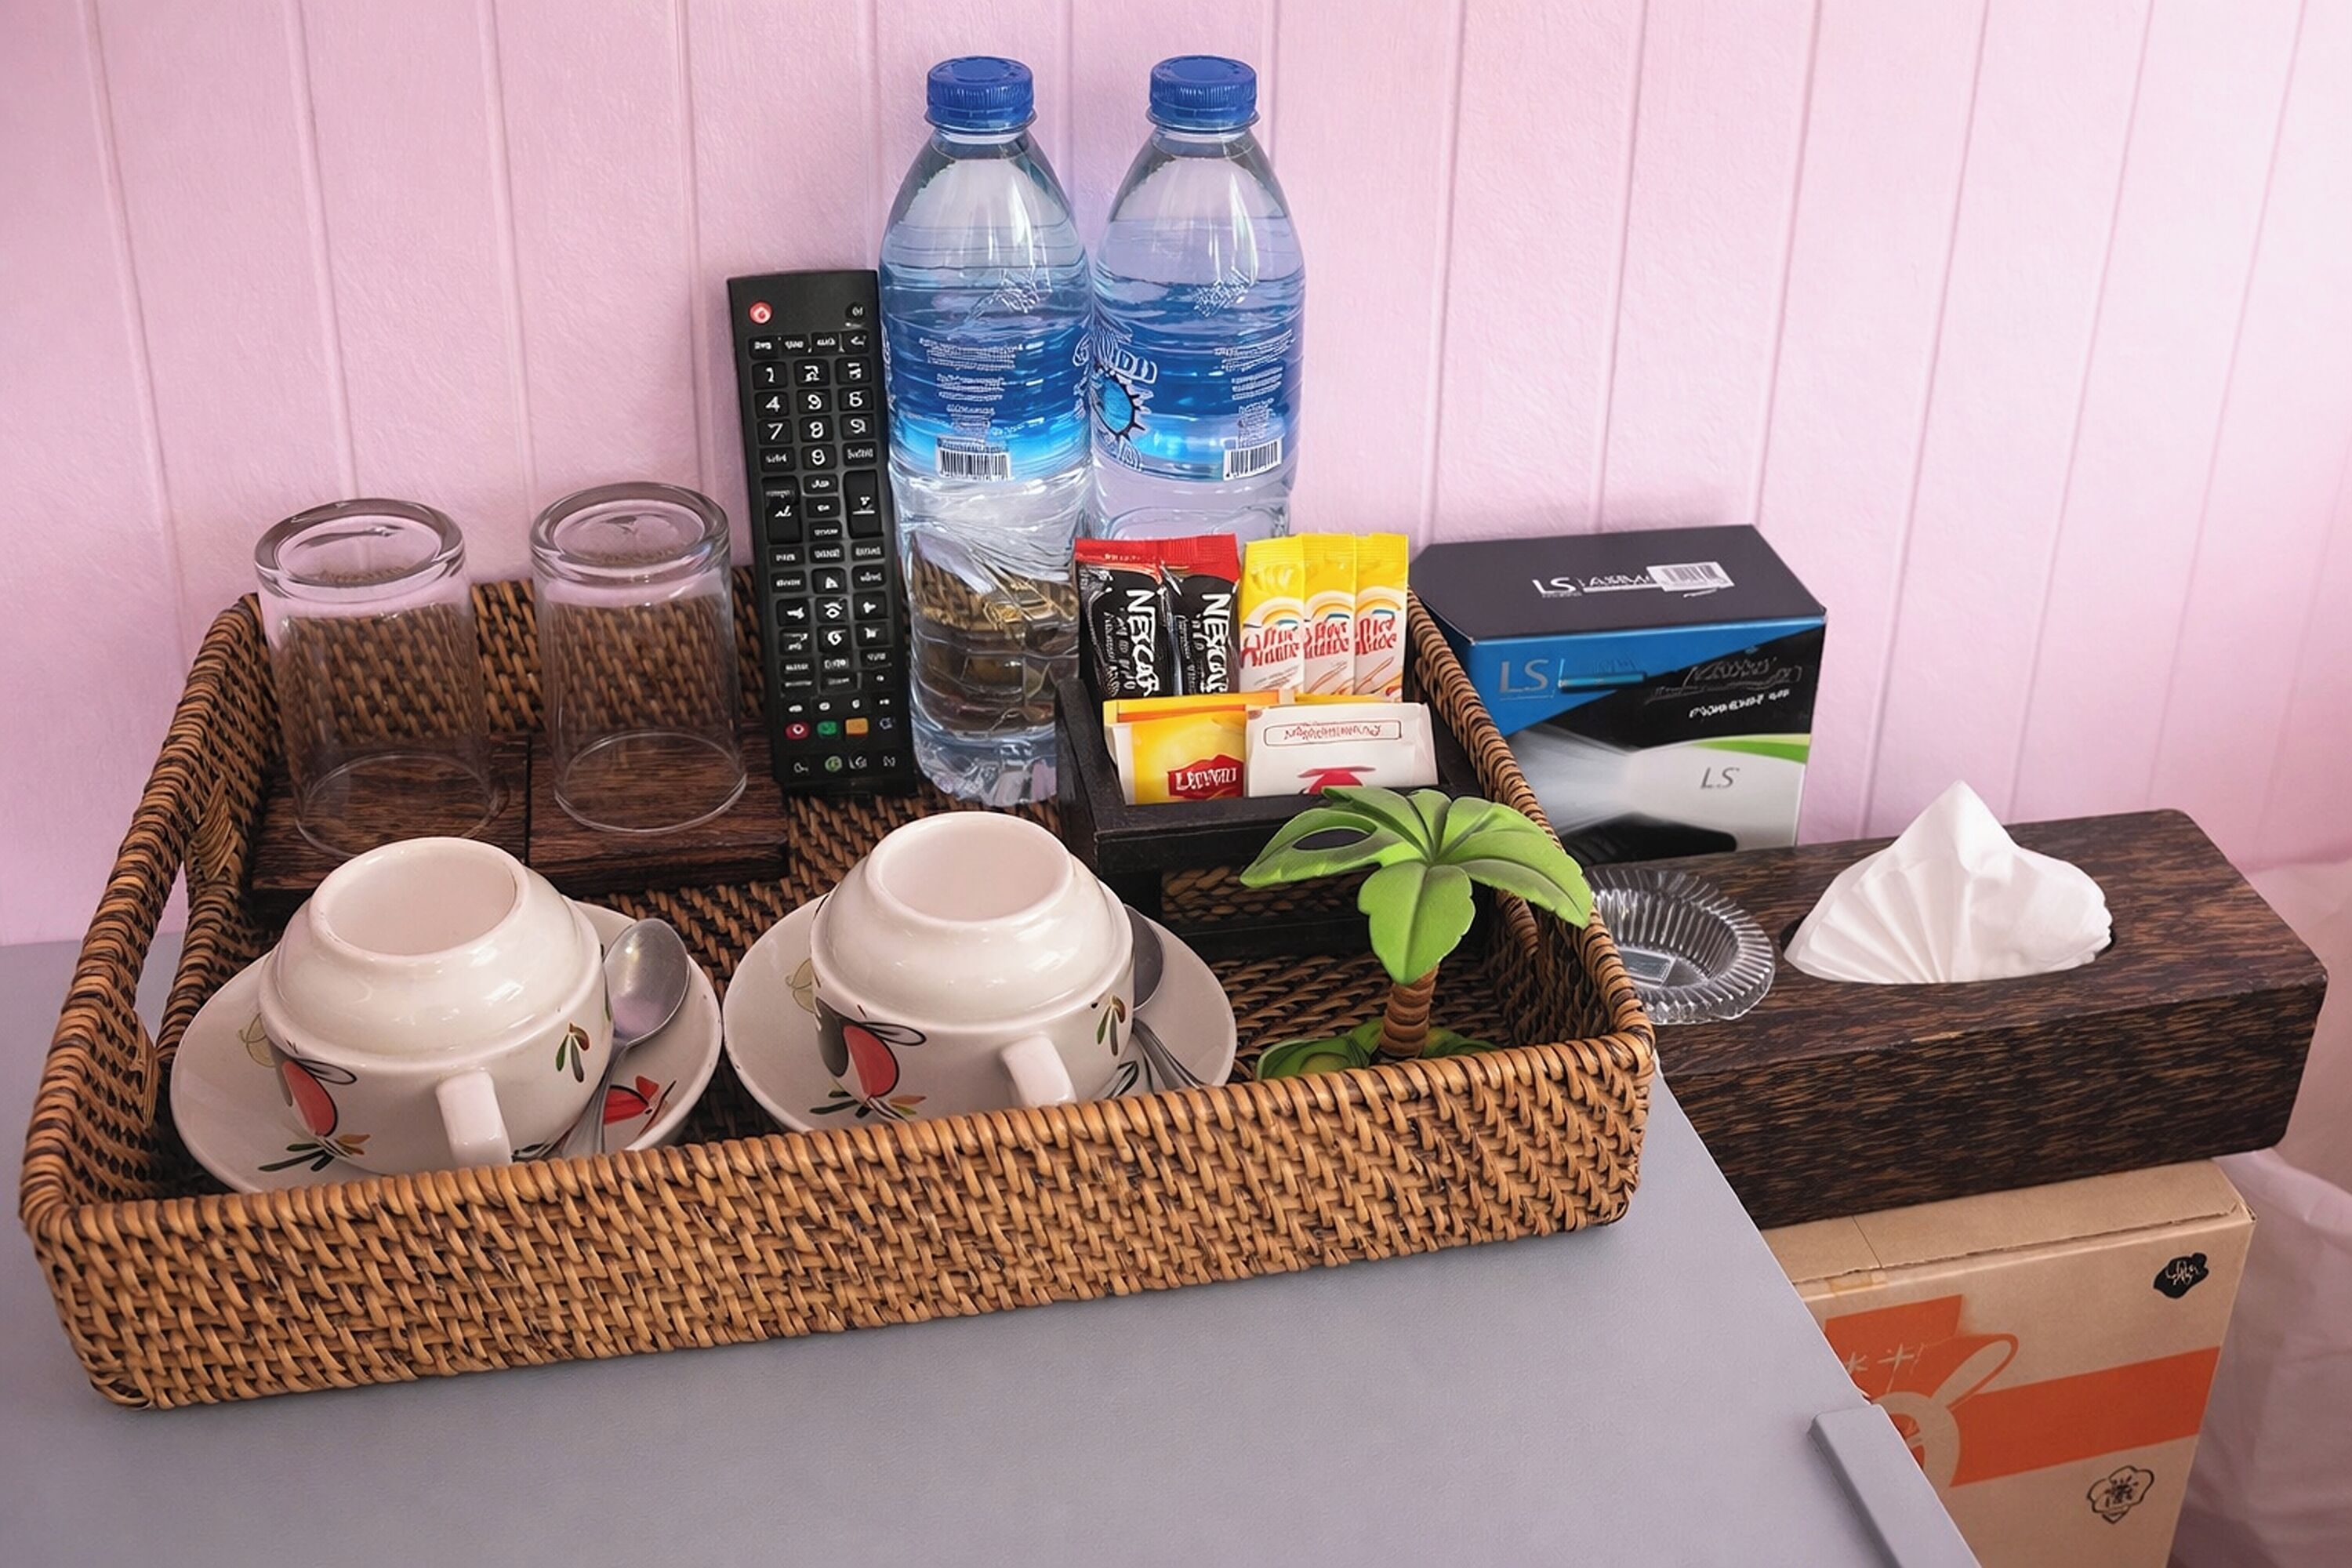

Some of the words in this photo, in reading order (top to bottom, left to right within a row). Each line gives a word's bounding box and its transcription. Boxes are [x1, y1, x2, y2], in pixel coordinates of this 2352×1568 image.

[765, 396, 780, 412] 4
[768, 422, 783, 440] 7
[809, 421, 823, 438] 8
[1500, 658, 1549, 694] LS
[1700, 767, 1740, 789] LS
